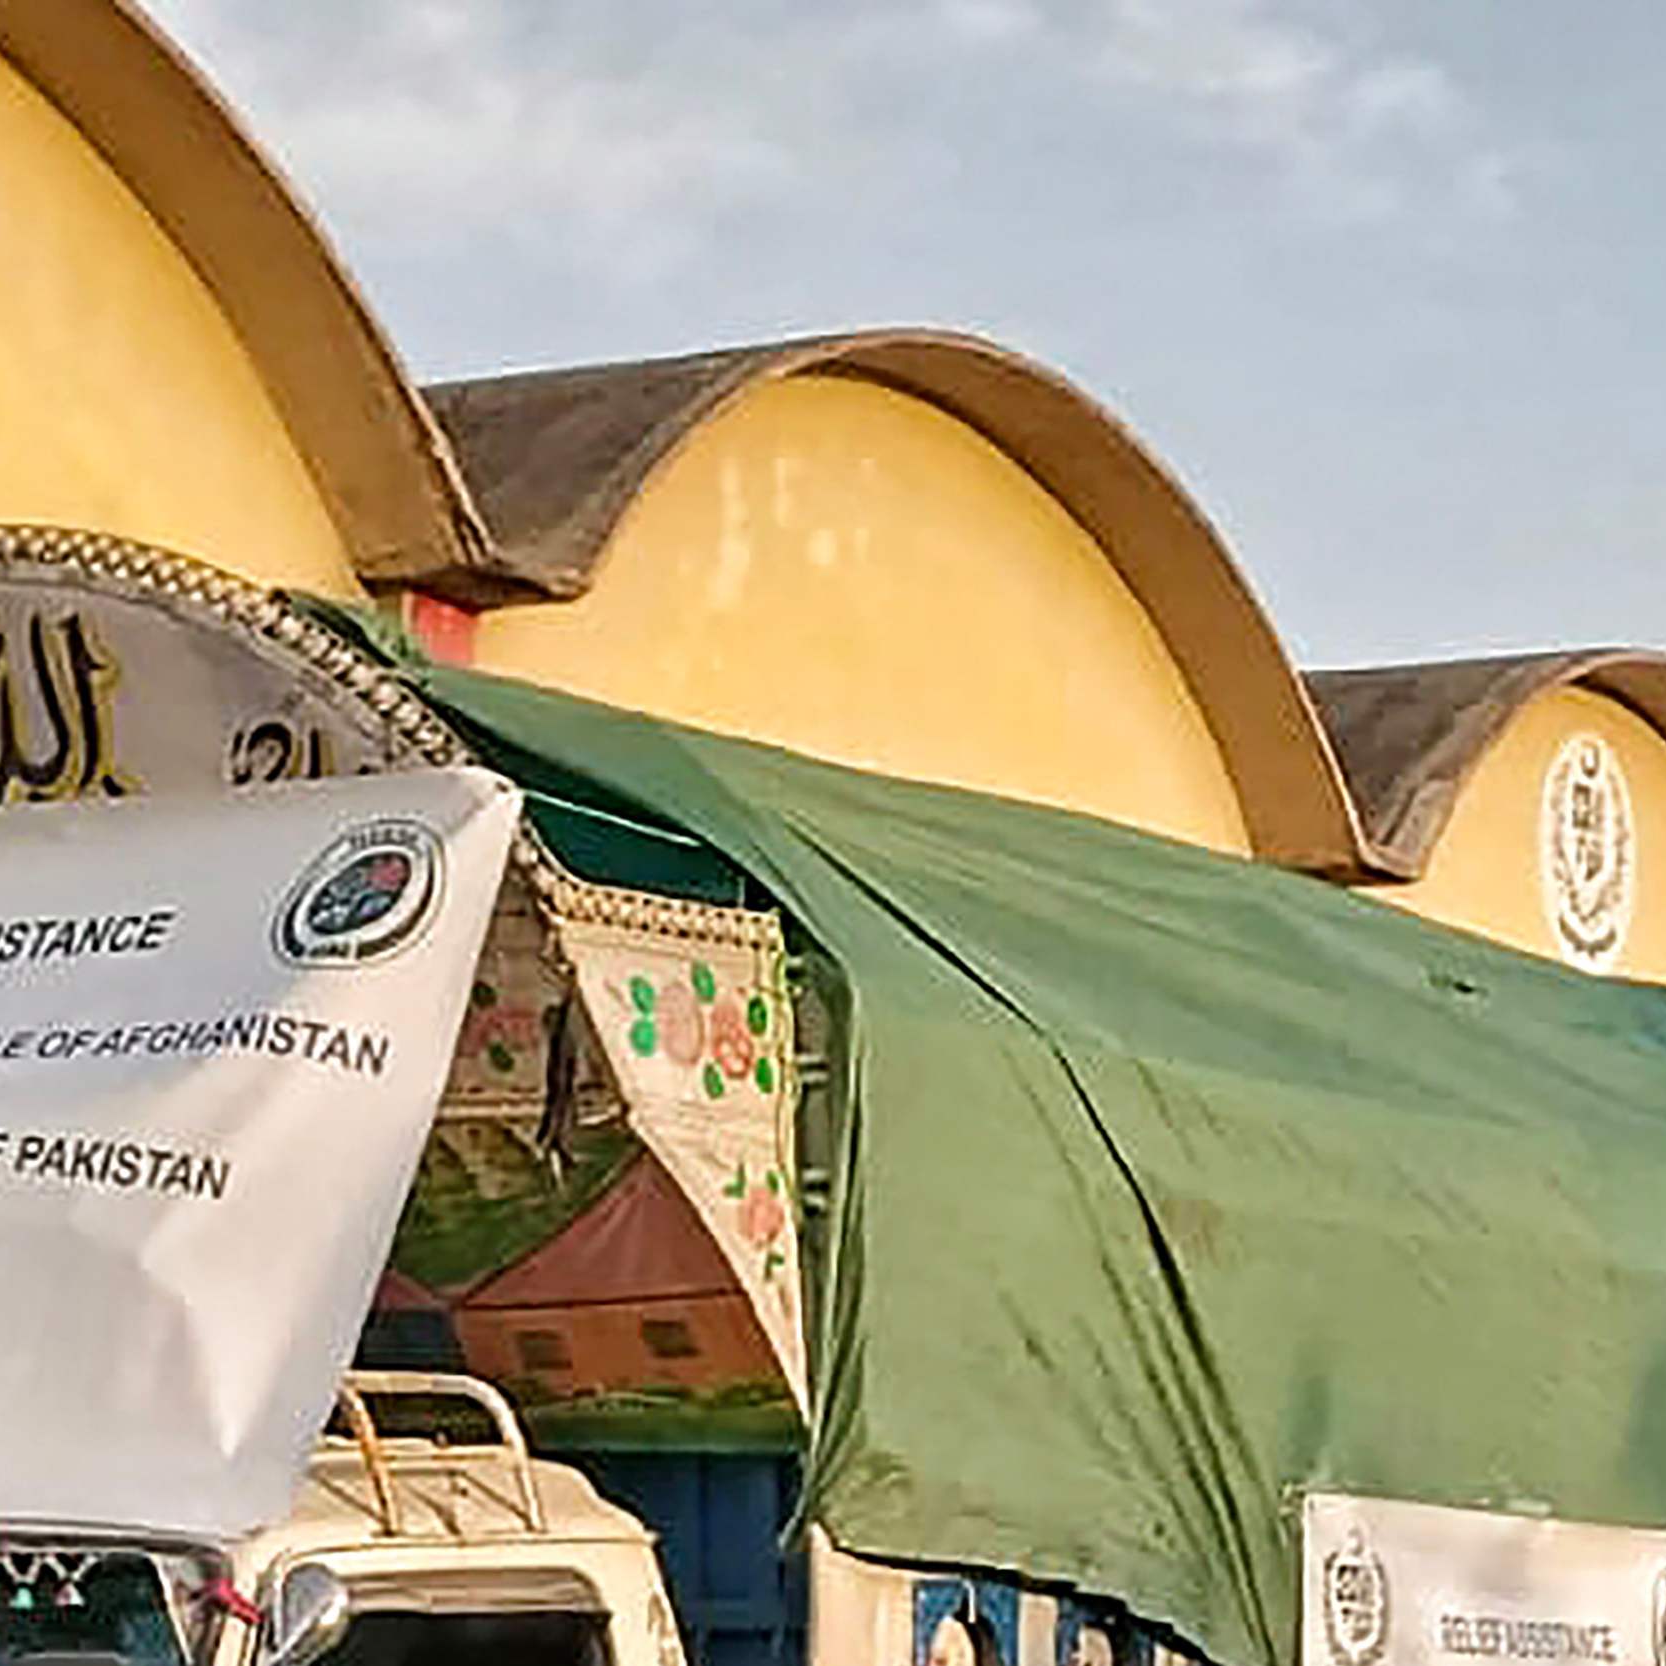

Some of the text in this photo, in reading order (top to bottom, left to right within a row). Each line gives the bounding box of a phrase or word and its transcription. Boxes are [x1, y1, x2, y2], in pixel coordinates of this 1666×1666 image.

[37, 1026, 100, 1062] OF
[94, 1013, 391, 1077] AFGHANISTAN
[14, 1136, 232, 1201] PAKISTAN
